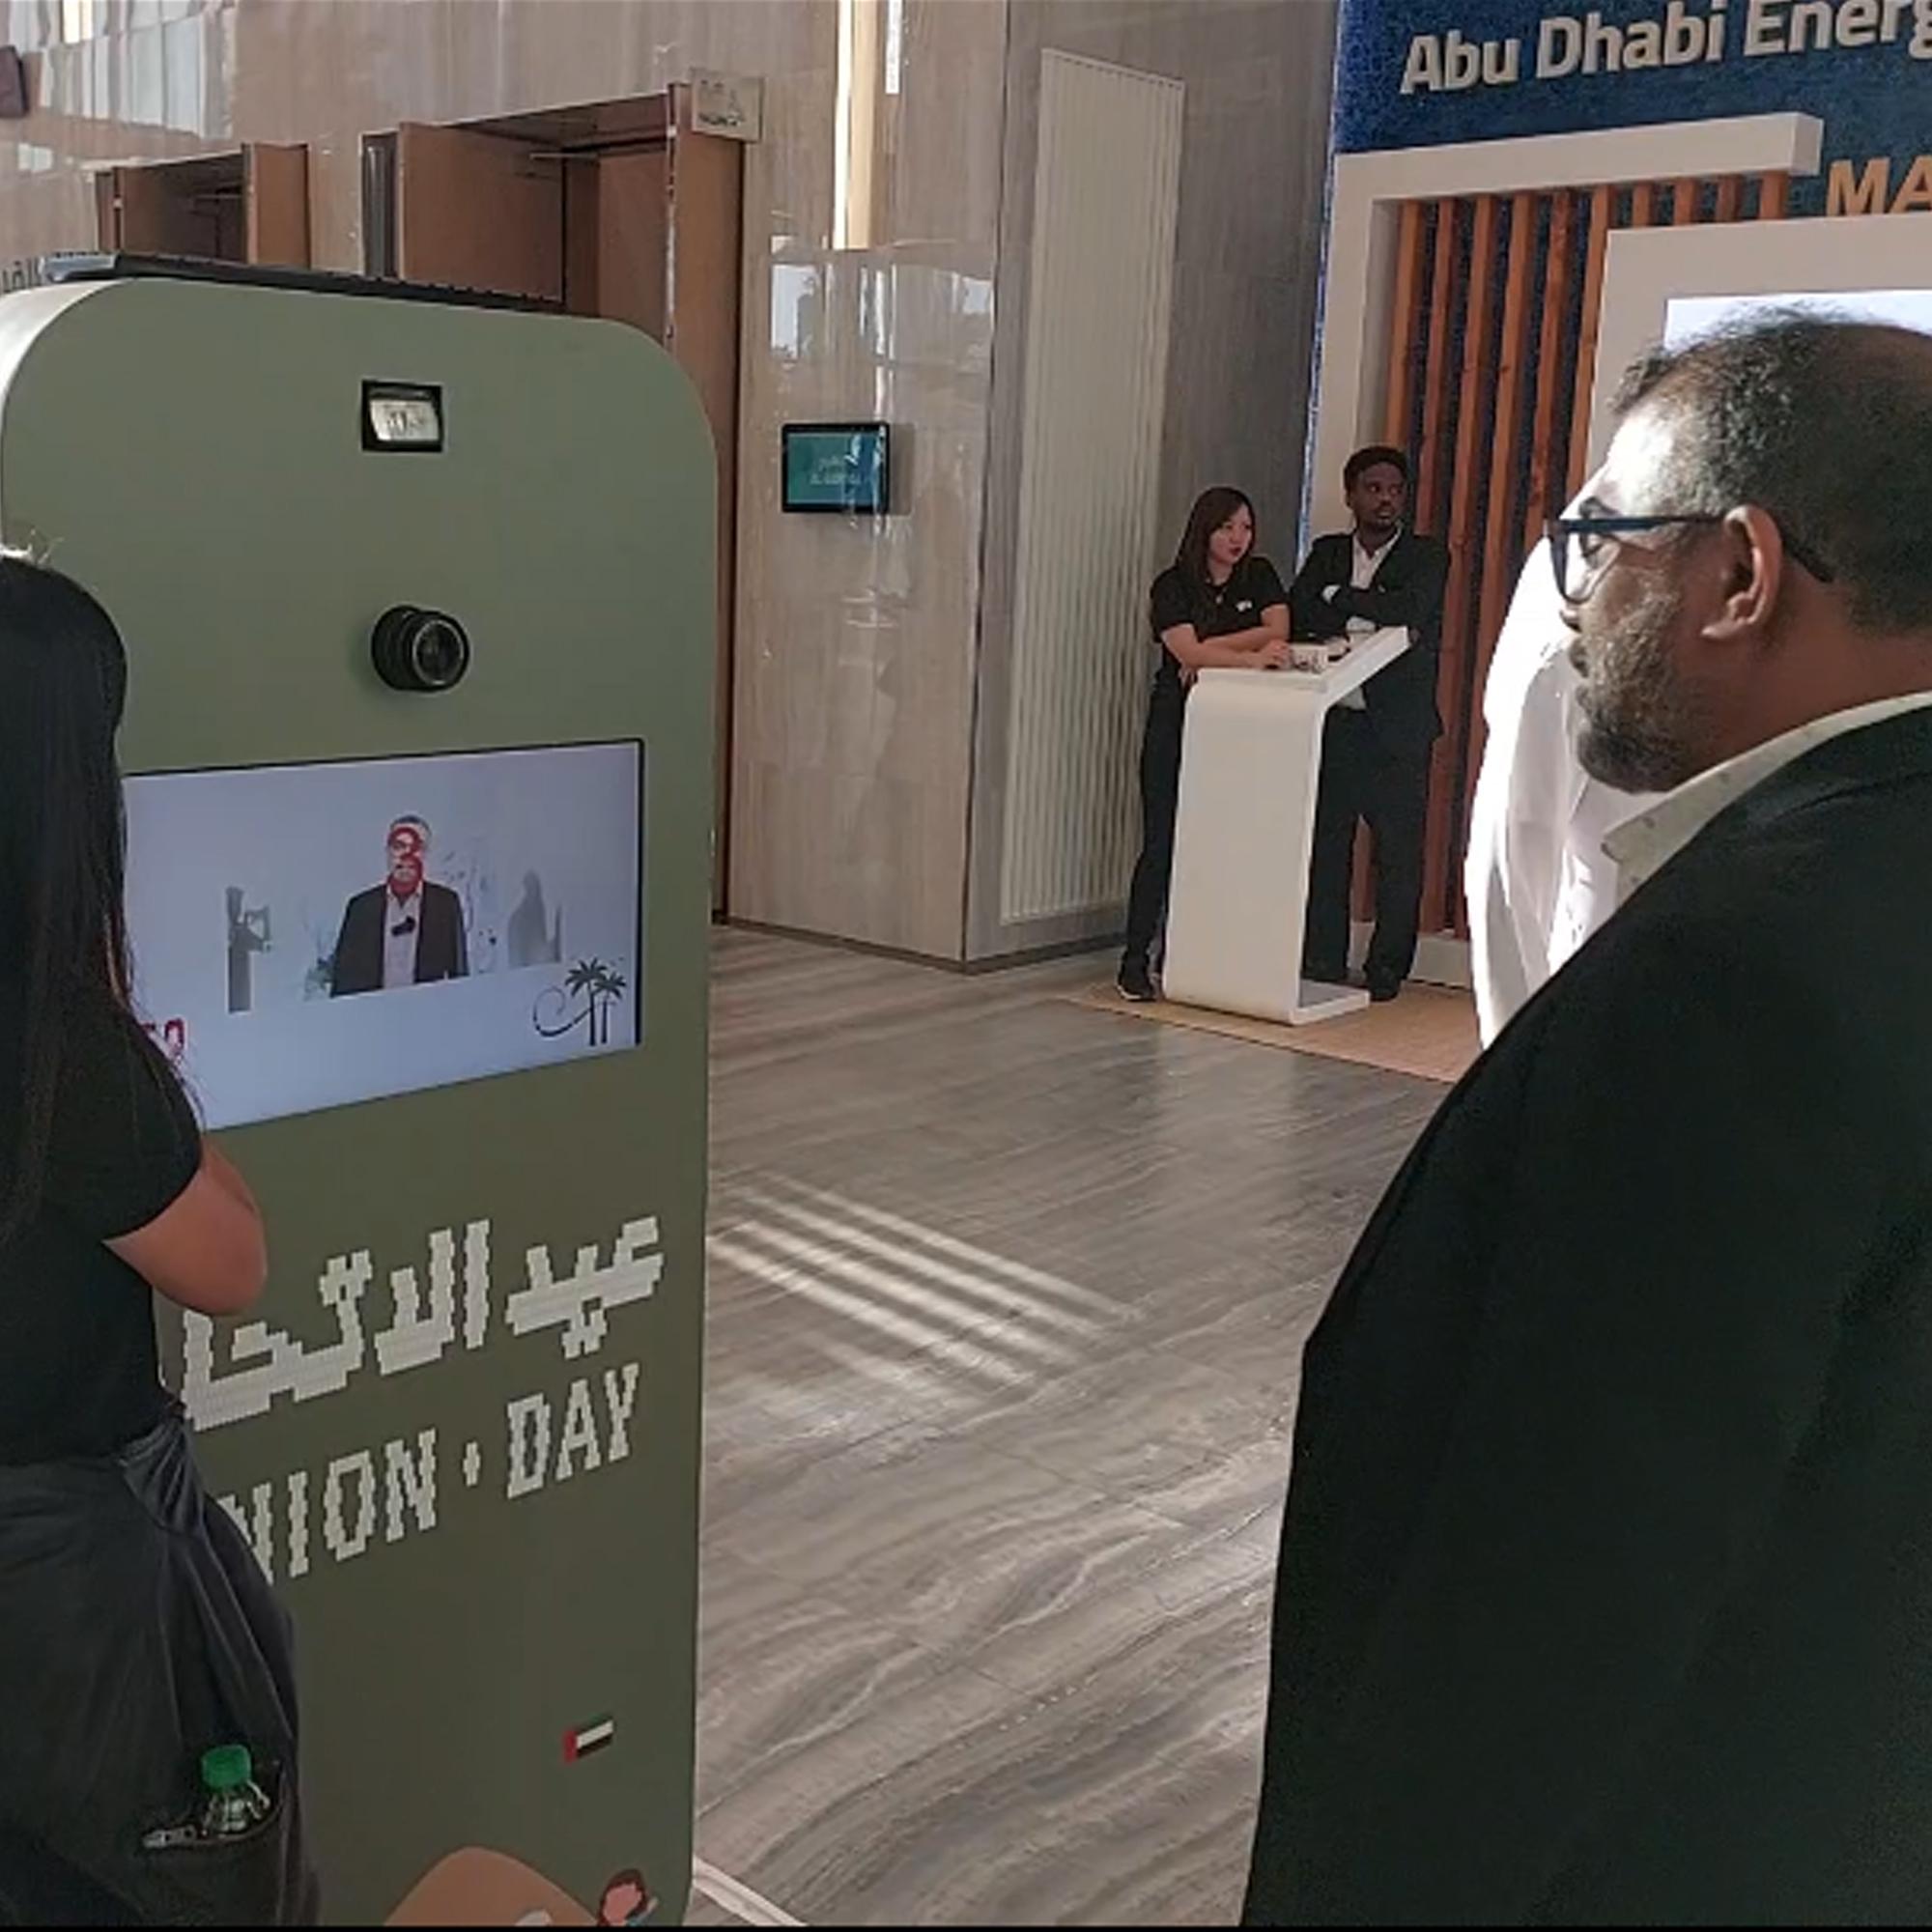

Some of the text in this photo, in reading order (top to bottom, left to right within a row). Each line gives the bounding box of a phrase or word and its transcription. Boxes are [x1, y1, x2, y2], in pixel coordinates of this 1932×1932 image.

[1400, 29, 1520, 95] Abu
[1536, 0, 1726, 79] Dhabi
[181, 1216, 664, 1432] عيد الاتحا
[216, 1363, 639, 1585] NION DAY
